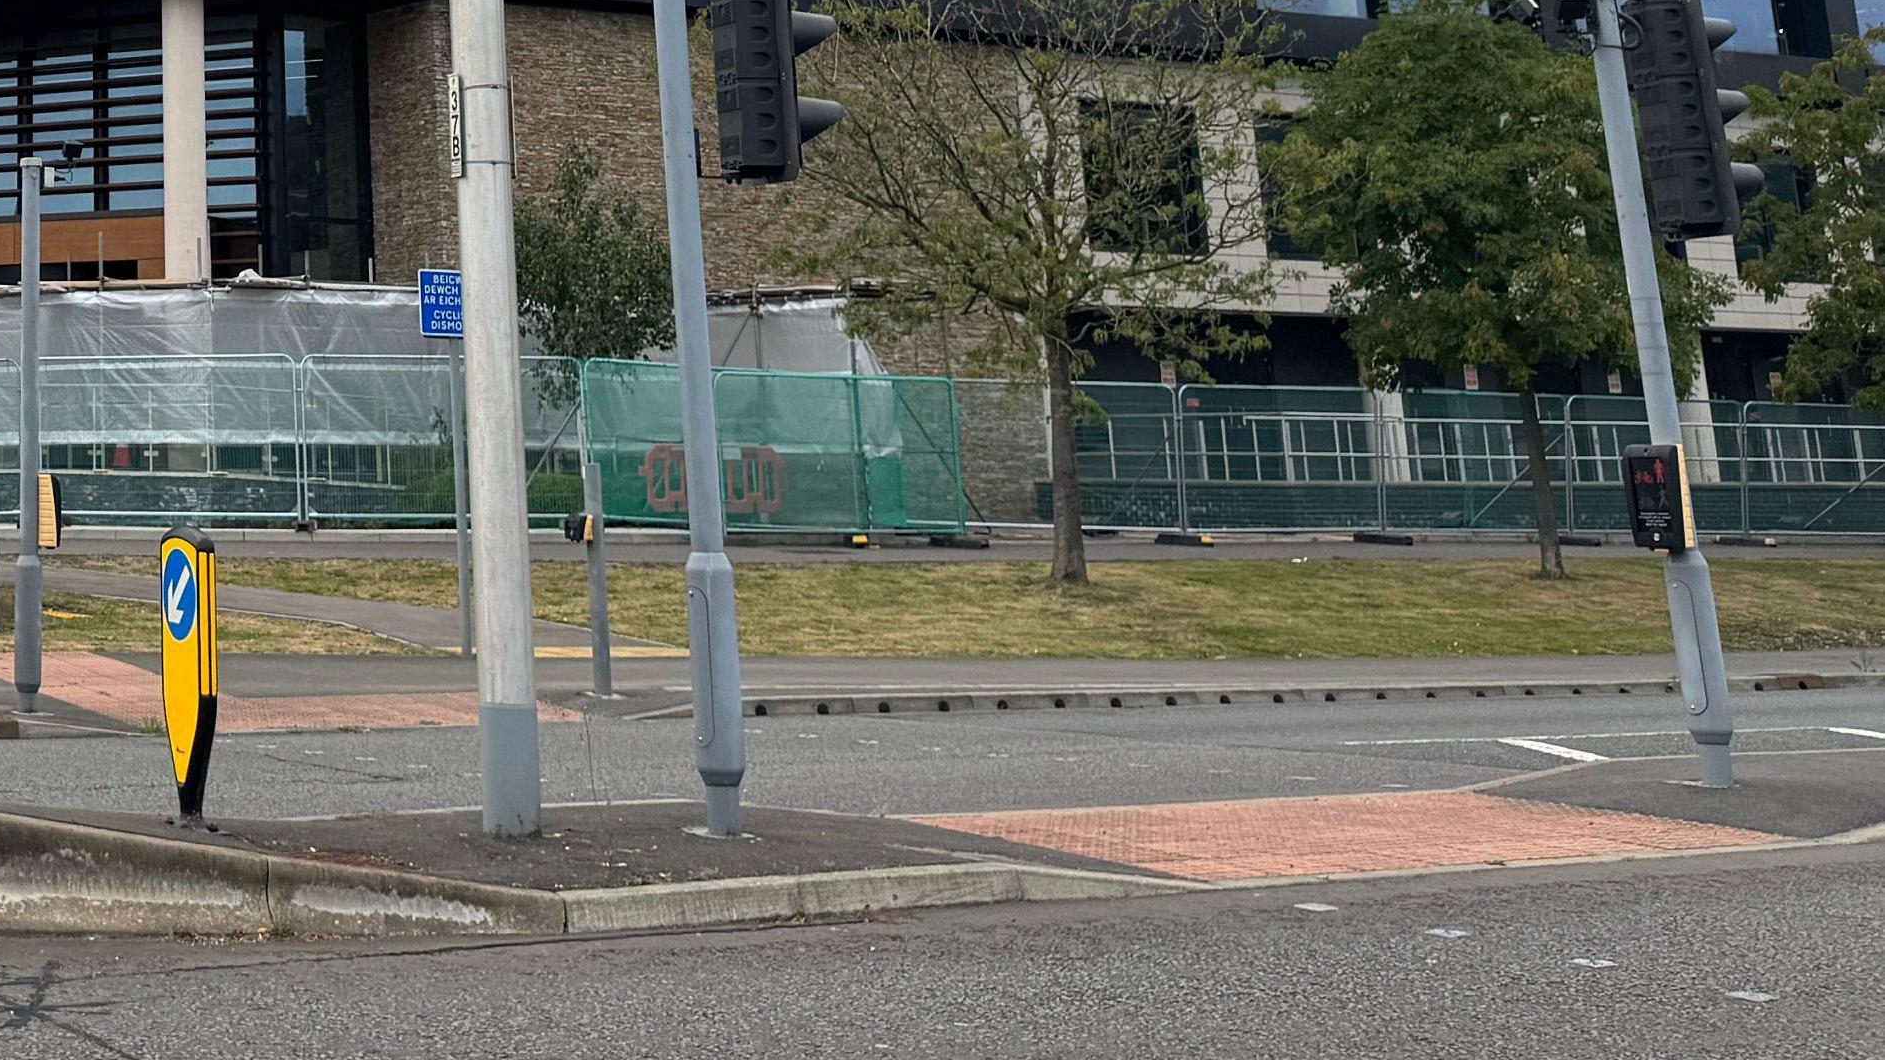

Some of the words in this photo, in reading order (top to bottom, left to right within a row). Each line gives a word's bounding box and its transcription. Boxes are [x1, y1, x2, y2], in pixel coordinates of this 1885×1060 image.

[433, 274, 461, 284] BEICW
[424, 285, 459, 295] DEWCH
[423, 295, 436, 305] AR
[439, 296, 461, 306] EICH
[433, 310, 463, 320] CYCLI
[431, 320, 462, 331] DISMO
